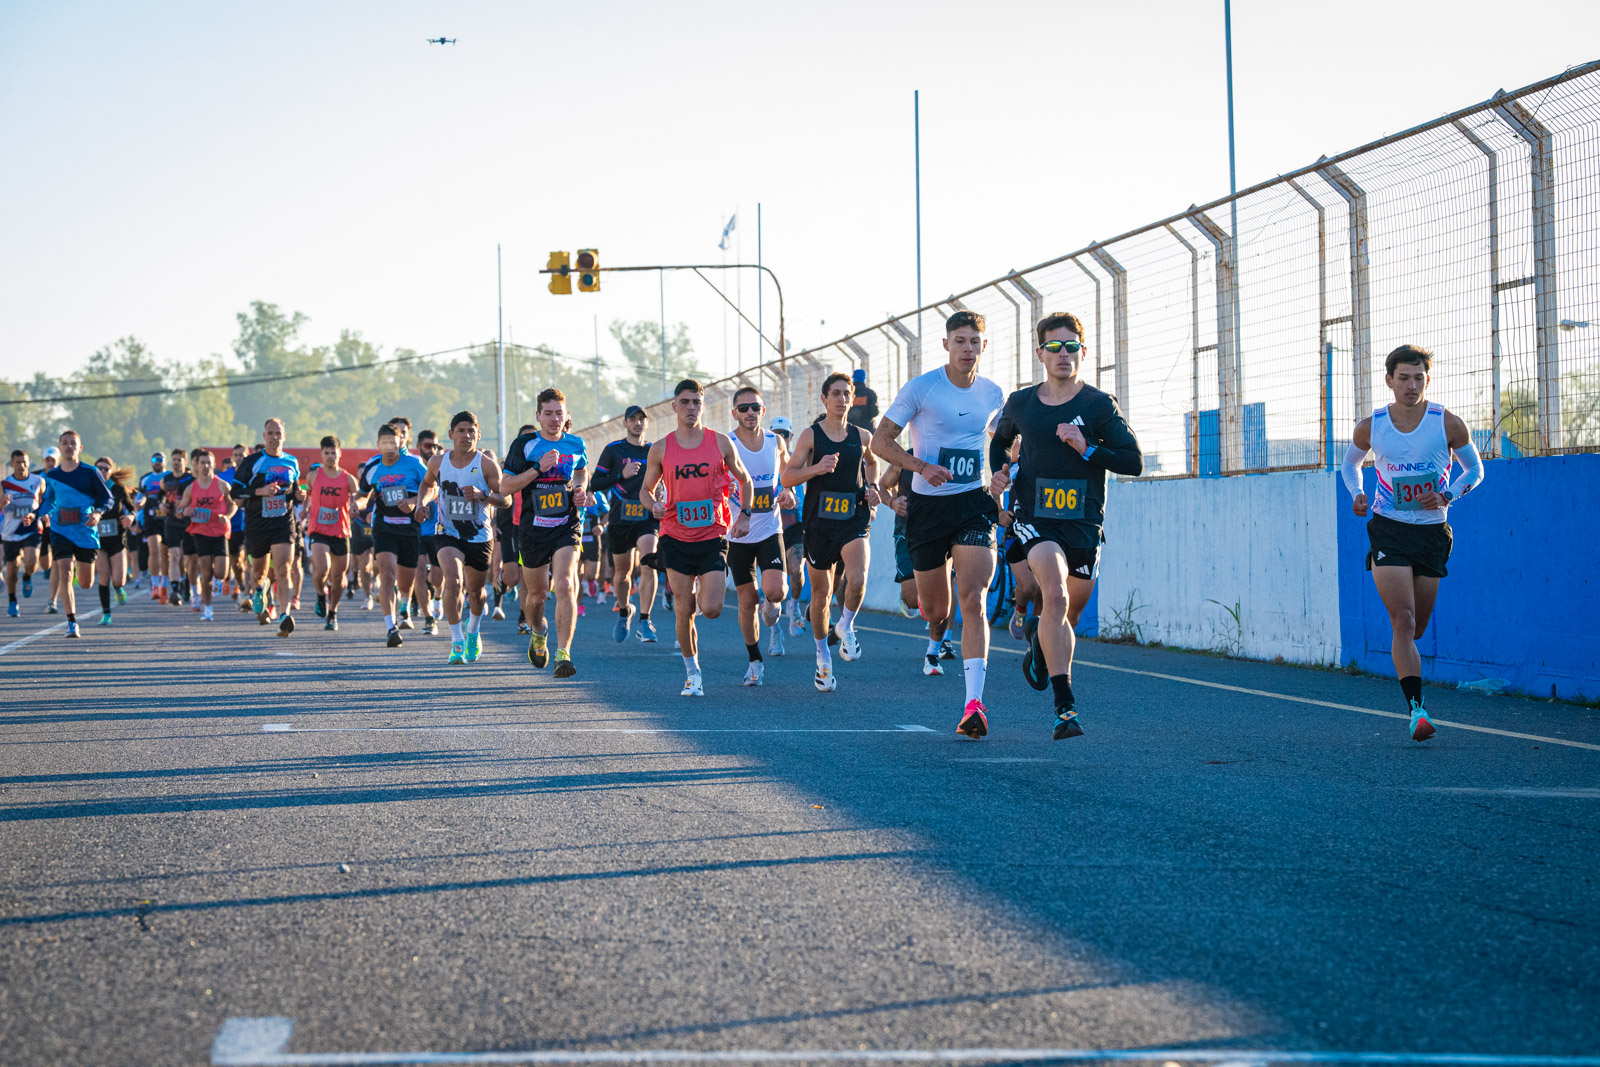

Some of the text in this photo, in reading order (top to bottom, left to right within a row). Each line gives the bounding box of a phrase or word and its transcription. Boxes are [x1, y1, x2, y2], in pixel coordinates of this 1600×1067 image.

[674, 462, 708, 480] KRC
[949, 456, 975, 477] 106
[1387, 461, 1436, 473] RUNNEA
[320, 486, 342, 496] KRC
[386, 490, 403, 502] 105
[267, 500, 283, 511] 359
[539, 492, 562, 509] 707
[825, 497, 849, 513] 718
[1044, 488, 1077, 509] 706
[451, 501, 473, 514] 174
[625, 503, 643, 517] 782
[683, 505, 707, 522] 313
[101, 524, 110, 533] 21
